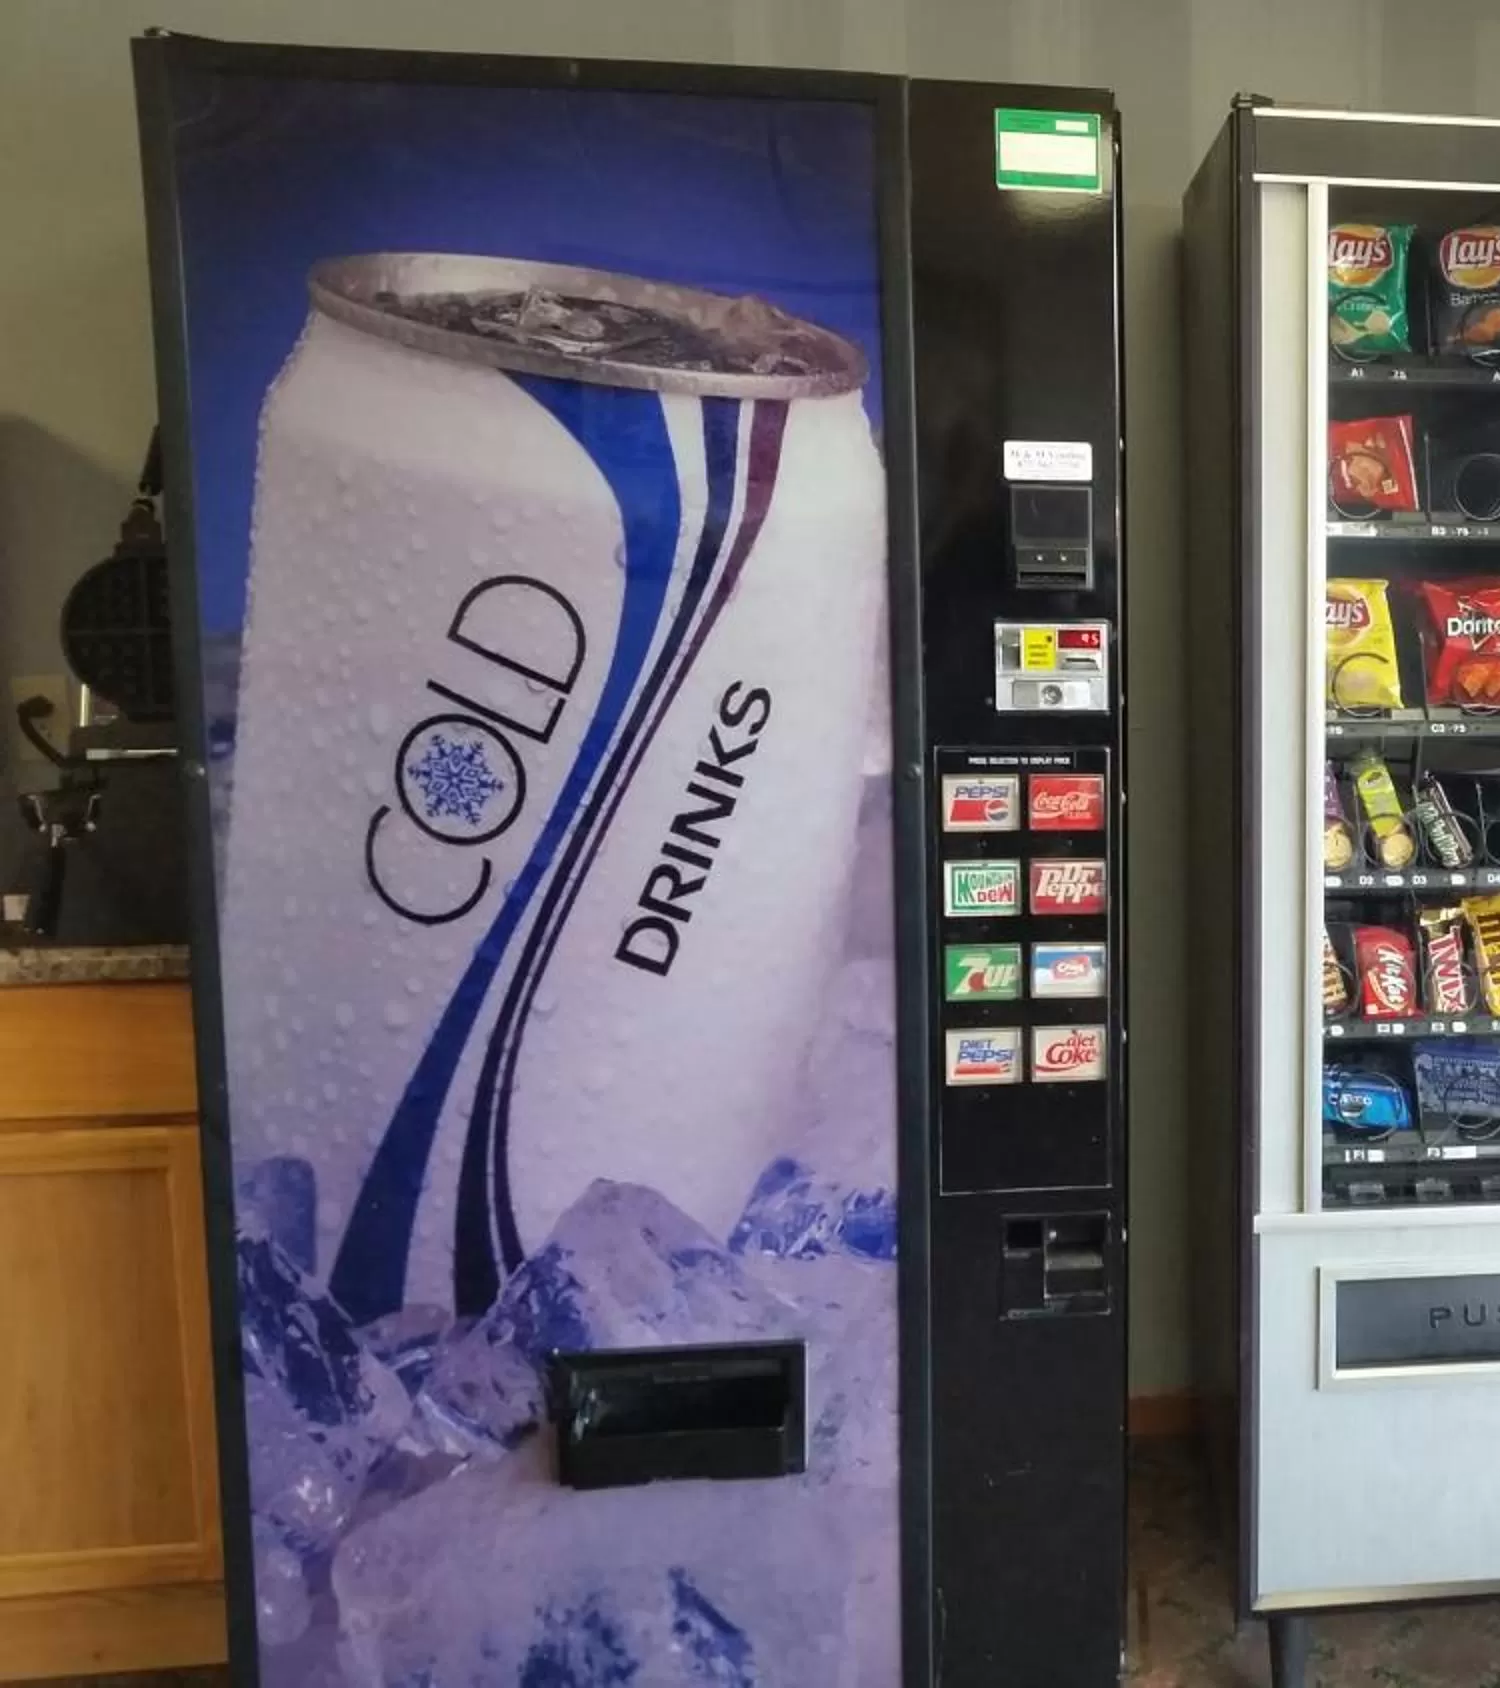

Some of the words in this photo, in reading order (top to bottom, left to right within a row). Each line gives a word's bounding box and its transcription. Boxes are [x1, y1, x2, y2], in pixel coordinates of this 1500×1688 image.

[1328, 233, 1387, 268] Lay's
[1326, 601, 1364, 628] ay's
[366, 575, 586, 925] COLD
[955, 786, 1009, 799] PEPSI
[614, 680, 772, 977] DRINKS
[953, 953, 1018, 995] 7UP
[1428, 925, 1469, 1013] TWIX
[960, 1039, 991, 1050] DIET
[1046, 1036, 1100, 1066] Coke
[1067, 1031, 1097, 1047] diet
[958, 1050, 1014, 1064] PEPSI
